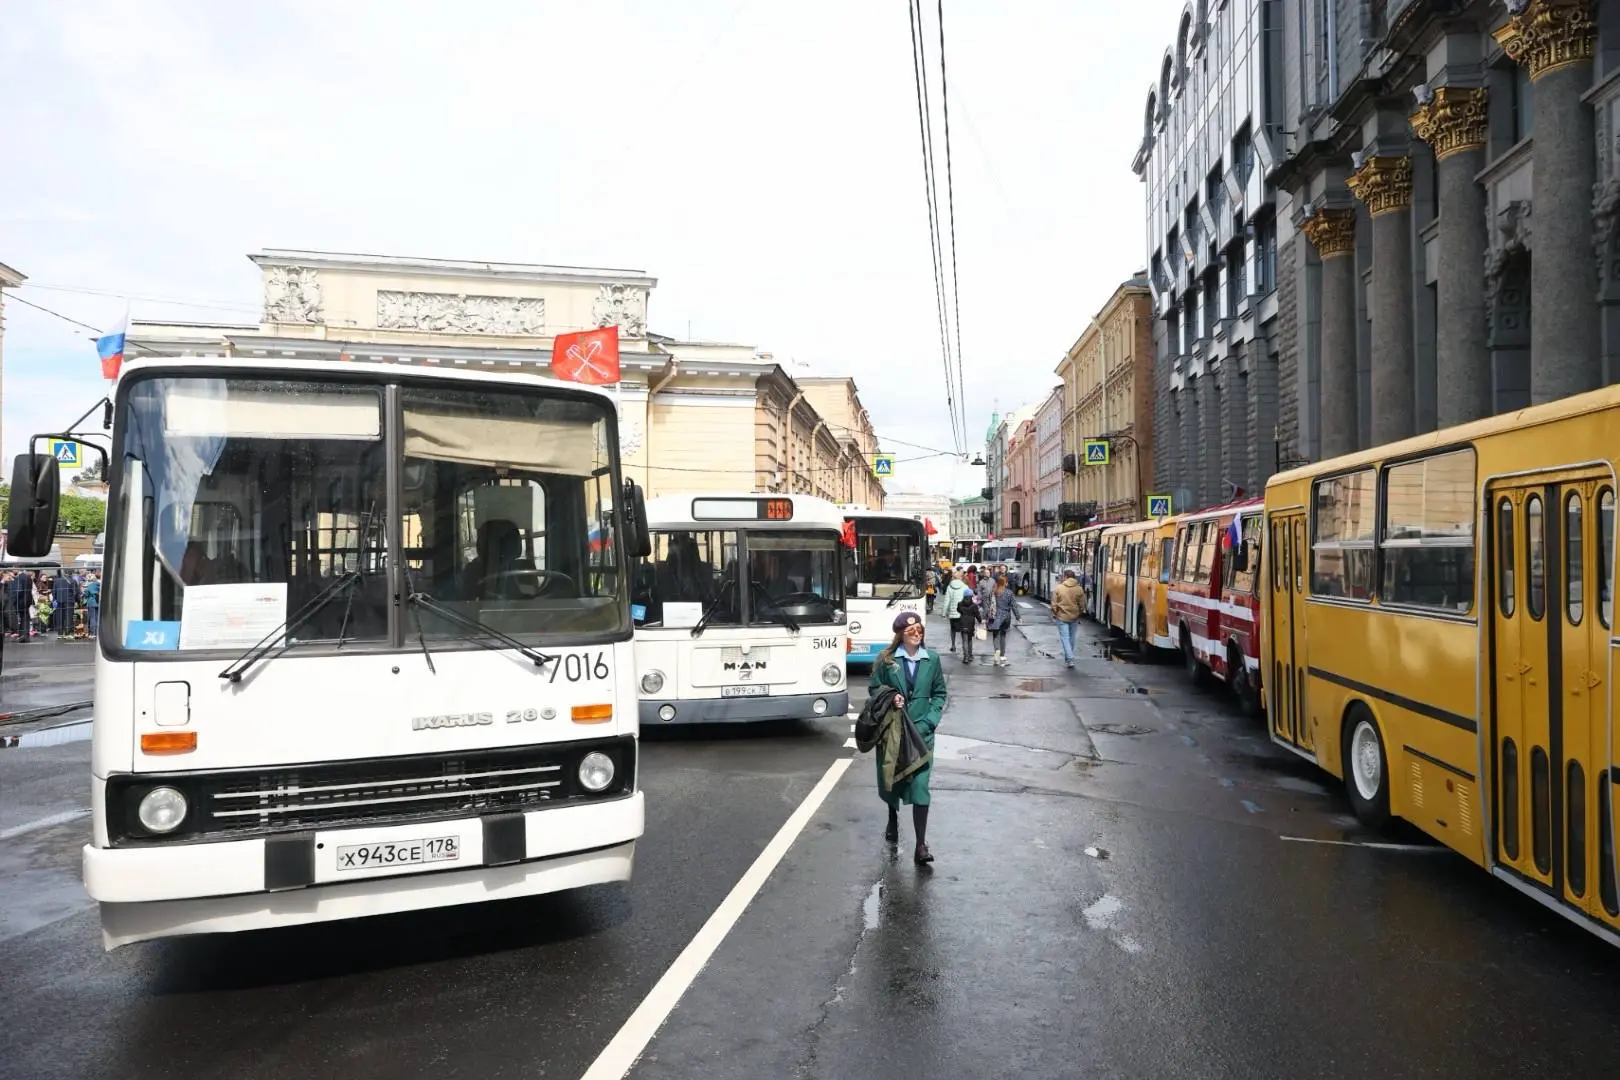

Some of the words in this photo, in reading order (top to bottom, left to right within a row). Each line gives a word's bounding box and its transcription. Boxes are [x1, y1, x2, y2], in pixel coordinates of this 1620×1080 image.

[813, 637, 838, 650] 5014
[548, 652, 609, 683] 7016
[412, 712, 494, 731] IKARUS
[506, 707, 557, 723] 280
[426, 838, 454, 853] 178
